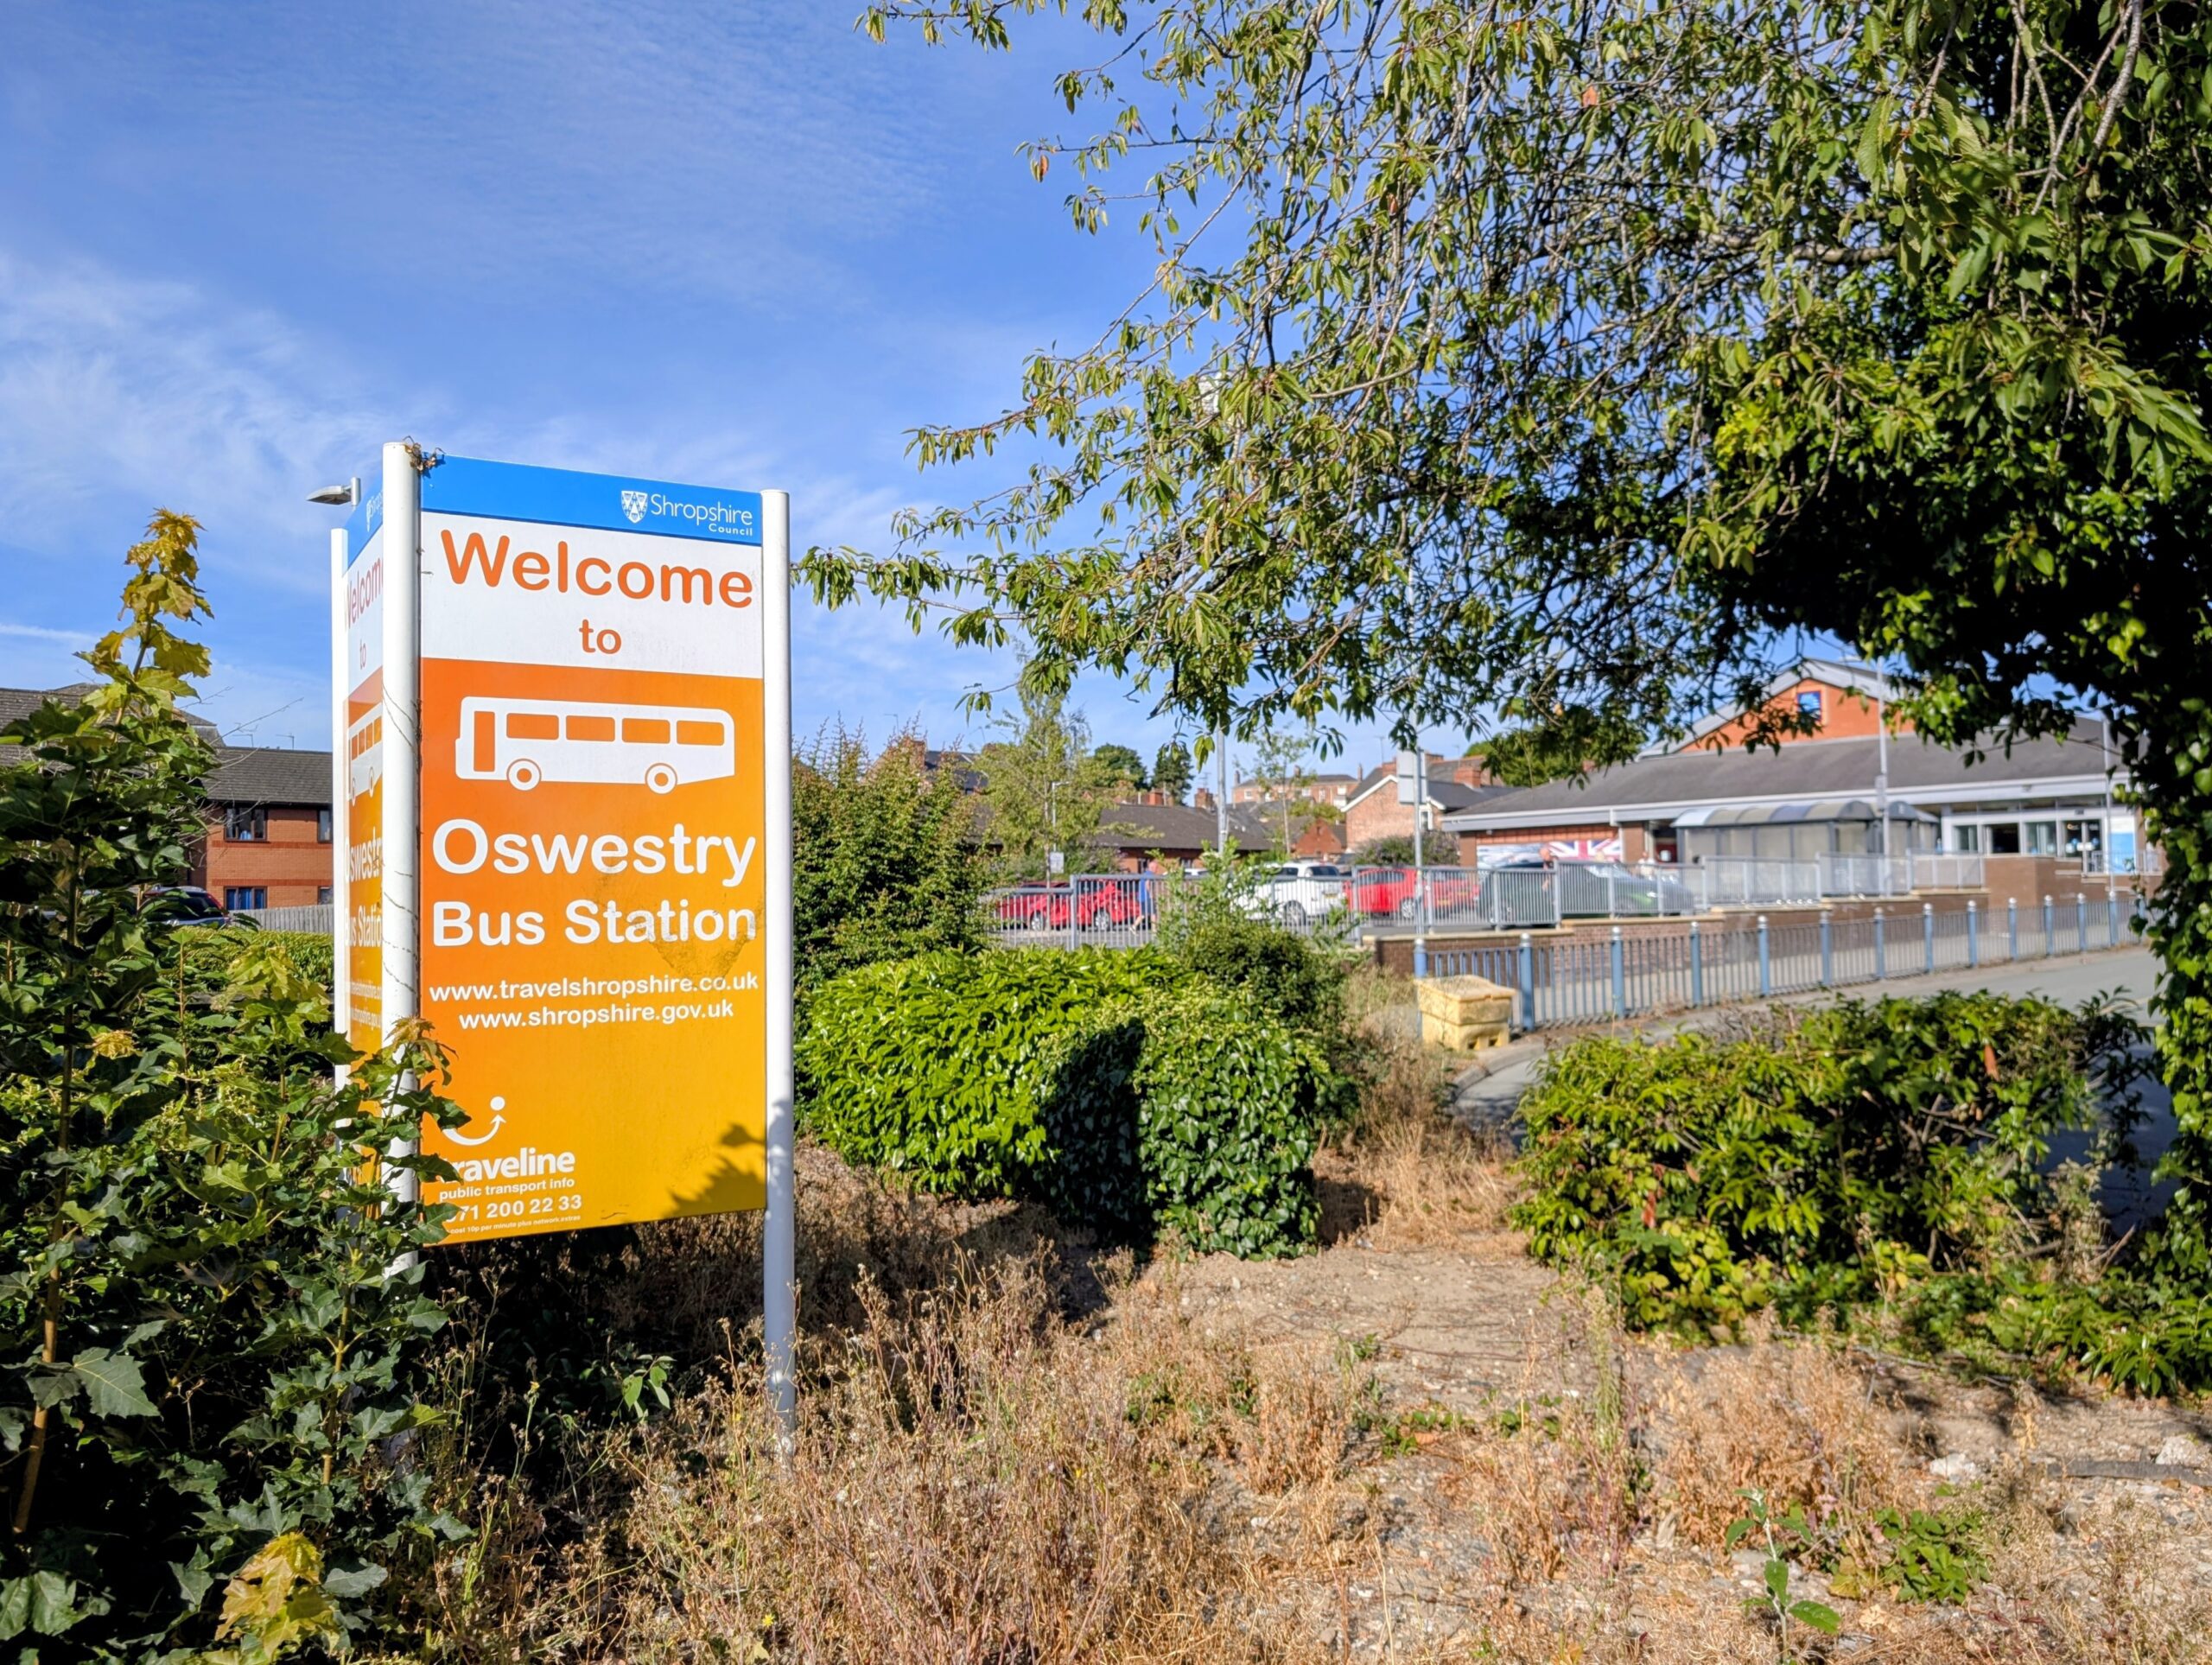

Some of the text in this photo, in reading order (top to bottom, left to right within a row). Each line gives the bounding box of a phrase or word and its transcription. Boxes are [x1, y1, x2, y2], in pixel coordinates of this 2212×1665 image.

[651, 493, 753, 526] Shropshire
[709, 523, 753, 537] Council
[441, 529, 753, 608] Welcome
[579, 619, 622, 655] to
[345, 827, 382, 883] Oswestr
[432, 818, 757, 888] Oswestry
[358, 903, 383, 948] Statio
[433, 899, 757, 947] Bus Station
[429, 971, 759, 1002] www.travelshropshire.co.uk
[459, 999, 734, 1030] www.shropshire.gov.uk
[439, 1177, 575, 1203] public transport info
[486, 1201, 524, 1219] 200
[529, 1198, 554, 1214] 22
[558, 1194, 582, 1211] 33
[518, 1219, 532, 1228] plus
